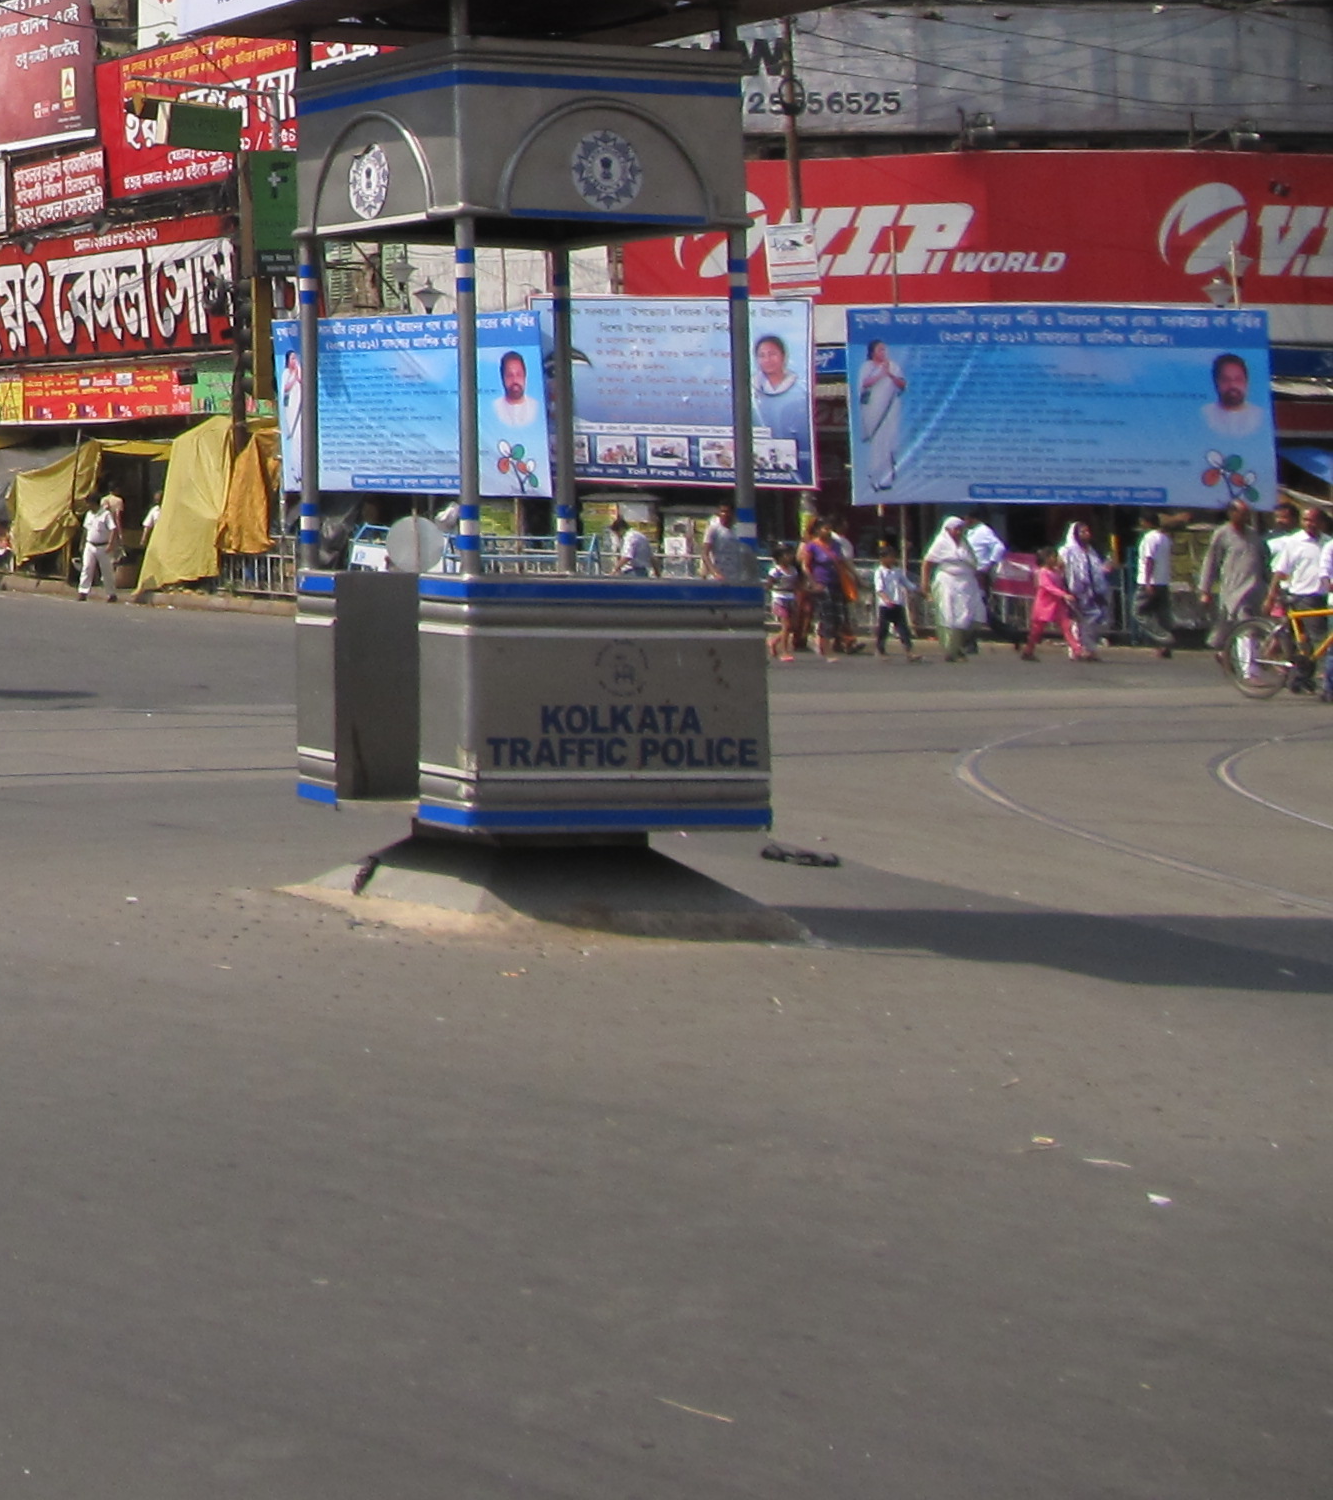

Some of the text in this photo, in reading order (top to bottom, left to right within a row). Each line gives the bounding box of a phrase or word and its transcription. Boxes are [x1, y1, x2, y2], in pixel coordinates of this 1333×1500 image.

[63, 3, 80, 23] সেই
[951, 251, 1067, 274] WORLD
[47, 248, 150, 345] বেঙ্গল
[627, 468, 648, 476] Toll
[649, 468, 675, 477] Free
[540, 704, 703, 737] KOLKATA
[486, 737, 759, 768] TRAFFIC POLICE
